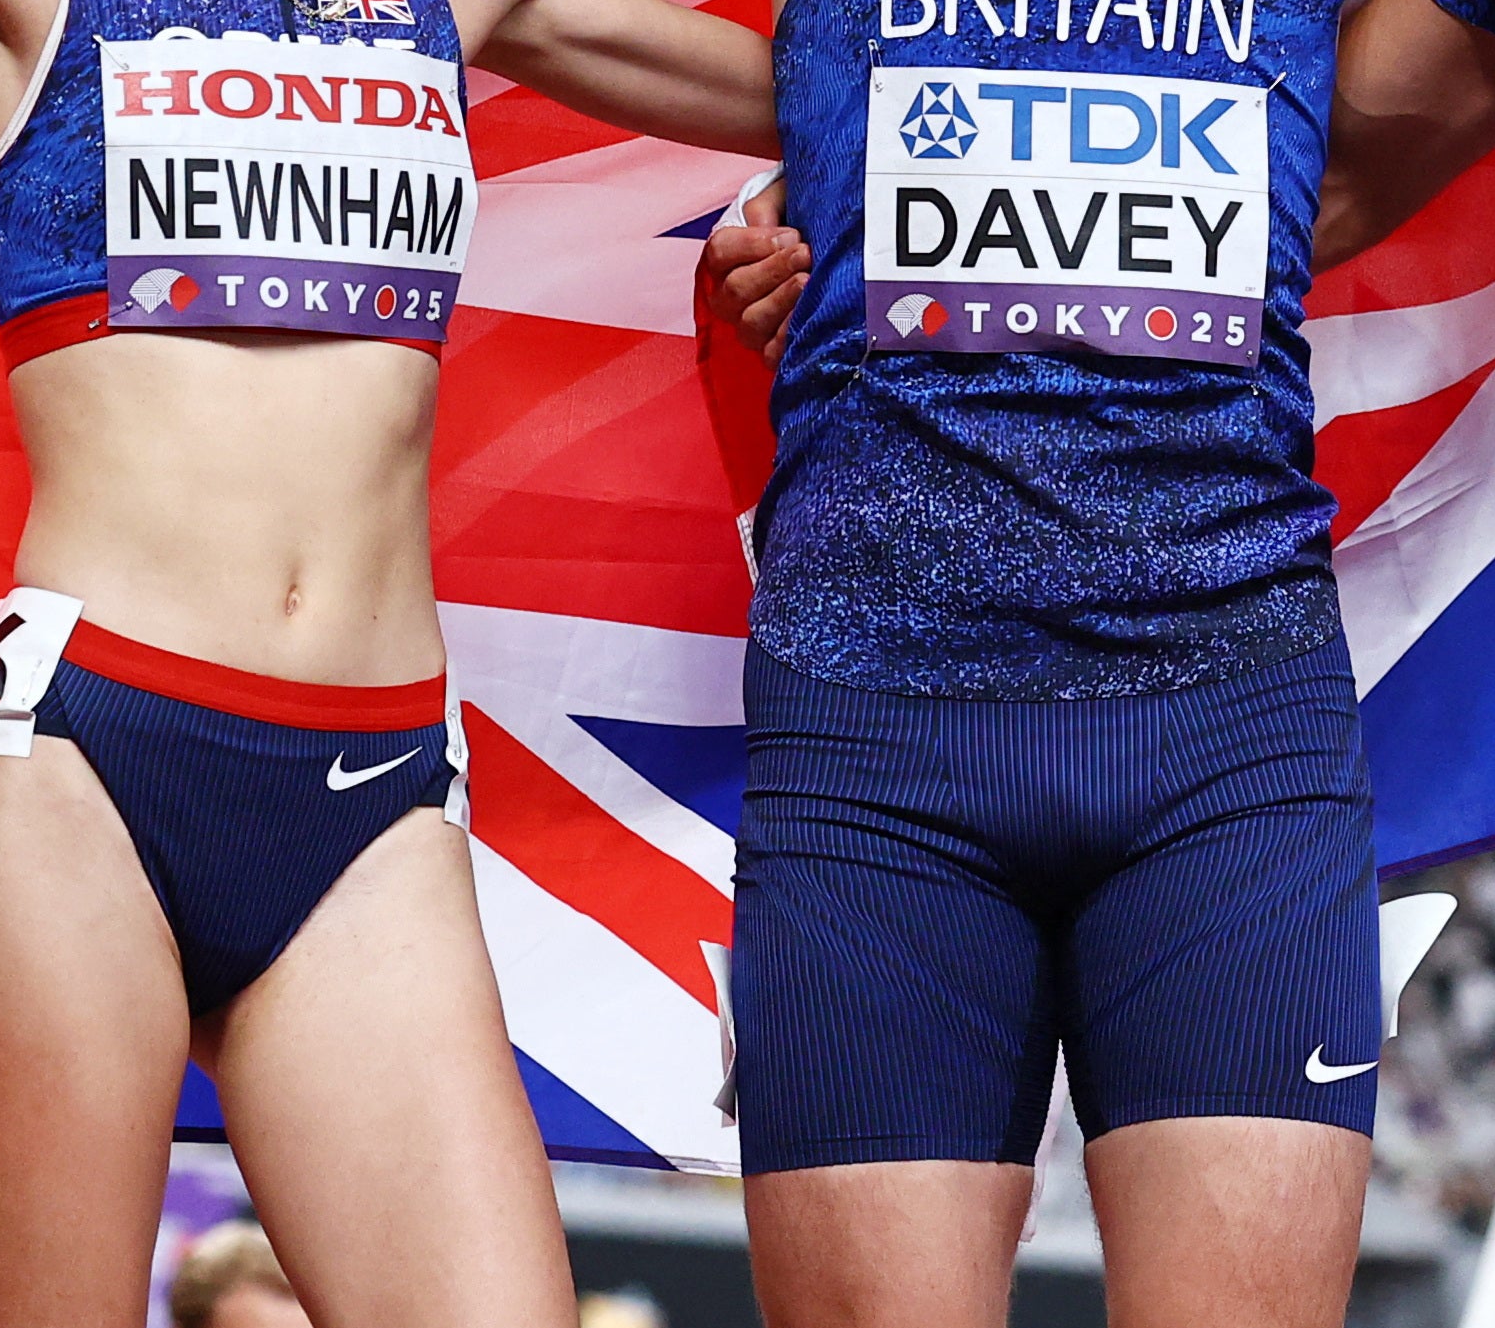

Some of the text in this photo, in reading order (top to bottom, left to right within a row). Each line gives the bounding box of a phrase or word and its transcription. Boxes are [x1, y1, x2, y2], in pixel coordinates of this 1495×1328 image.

[113, 69, 461, 138] HONDA
[978, 83, 1239, 176] TDK
[130, 158, 463, 256] NEWNHAM
[896, 187, 1243, 278] DAVEY
